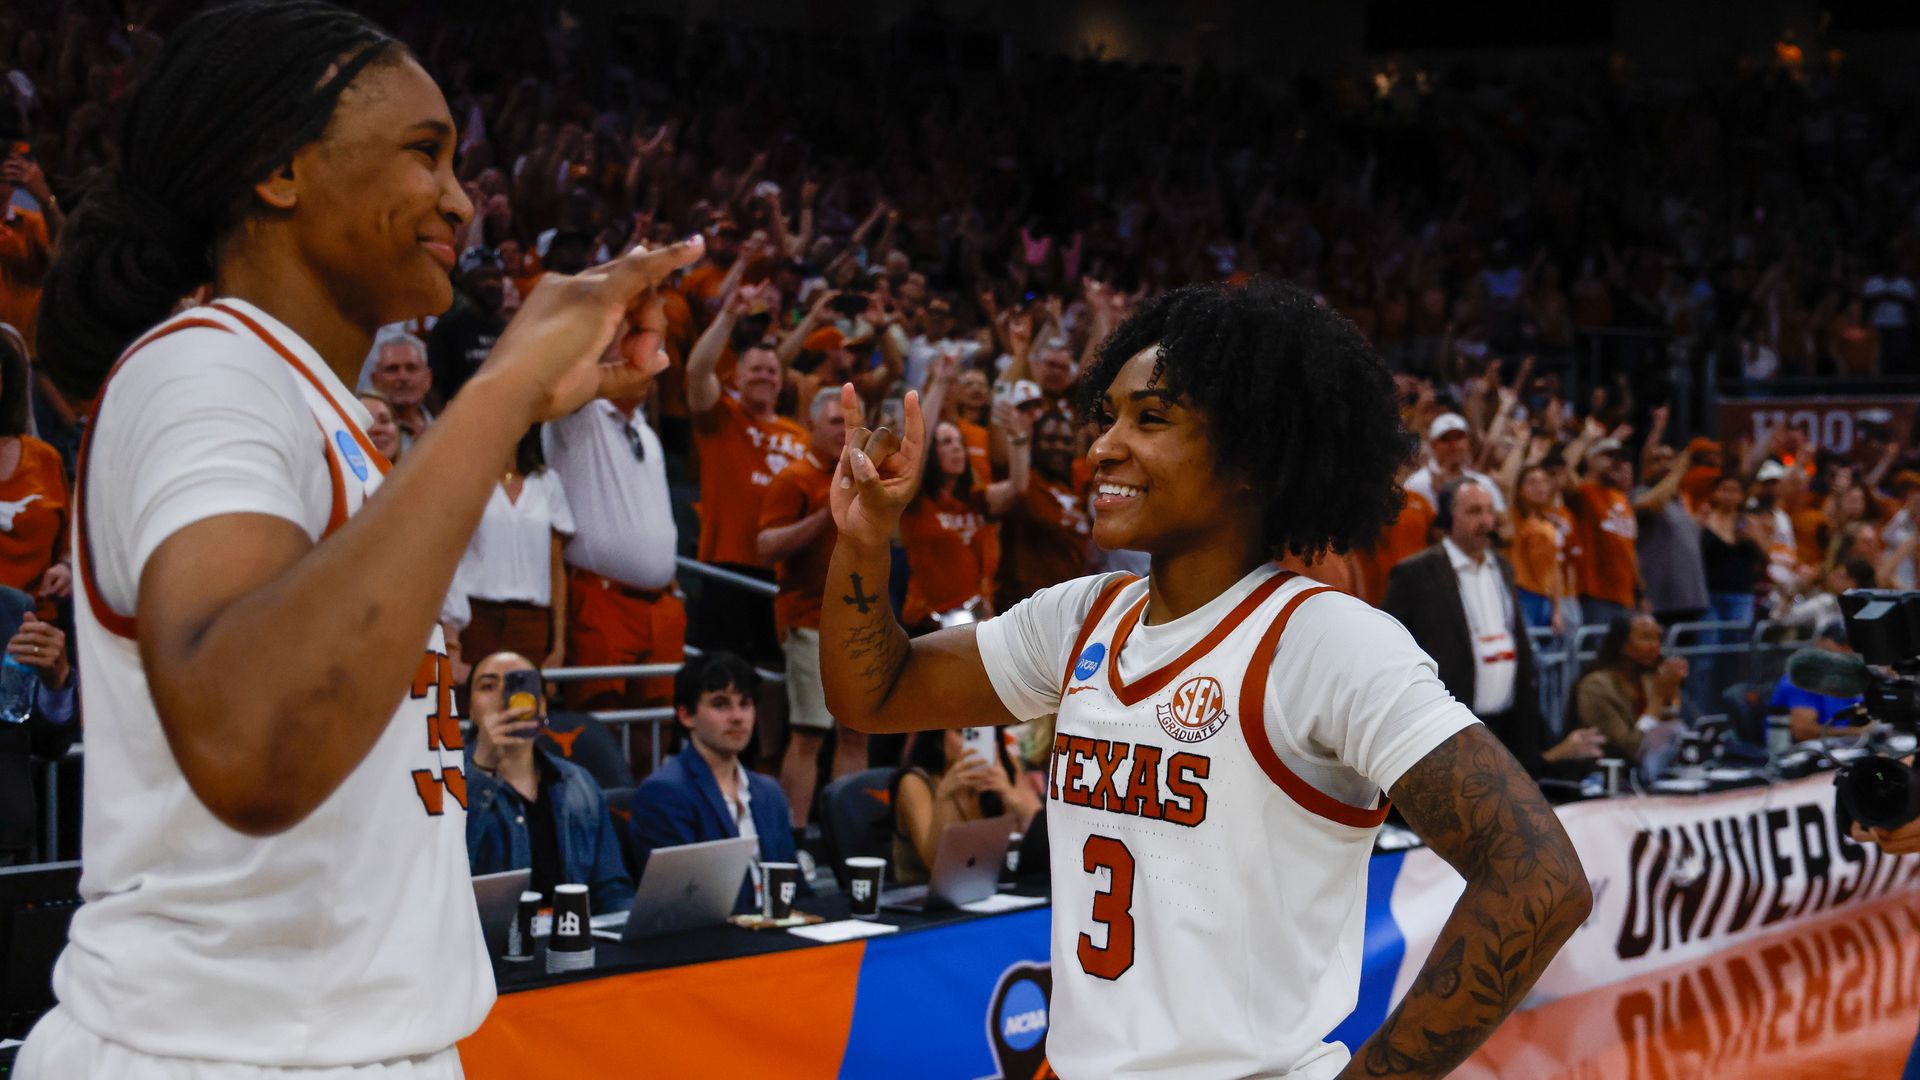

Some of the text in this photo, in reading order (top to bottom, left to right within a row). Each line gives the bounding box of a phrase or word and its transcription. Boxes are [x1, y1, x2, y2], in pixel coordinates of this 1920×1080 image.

[1174, 679, 1220, 725] SEC
[1161, 716, 1217, 741] GRADUATE
[1050, 732, 1211, 828] TEXAS
[1077, 833, 1136, 982] 3
[1005, 1007, 1047, 1037] NCAA
